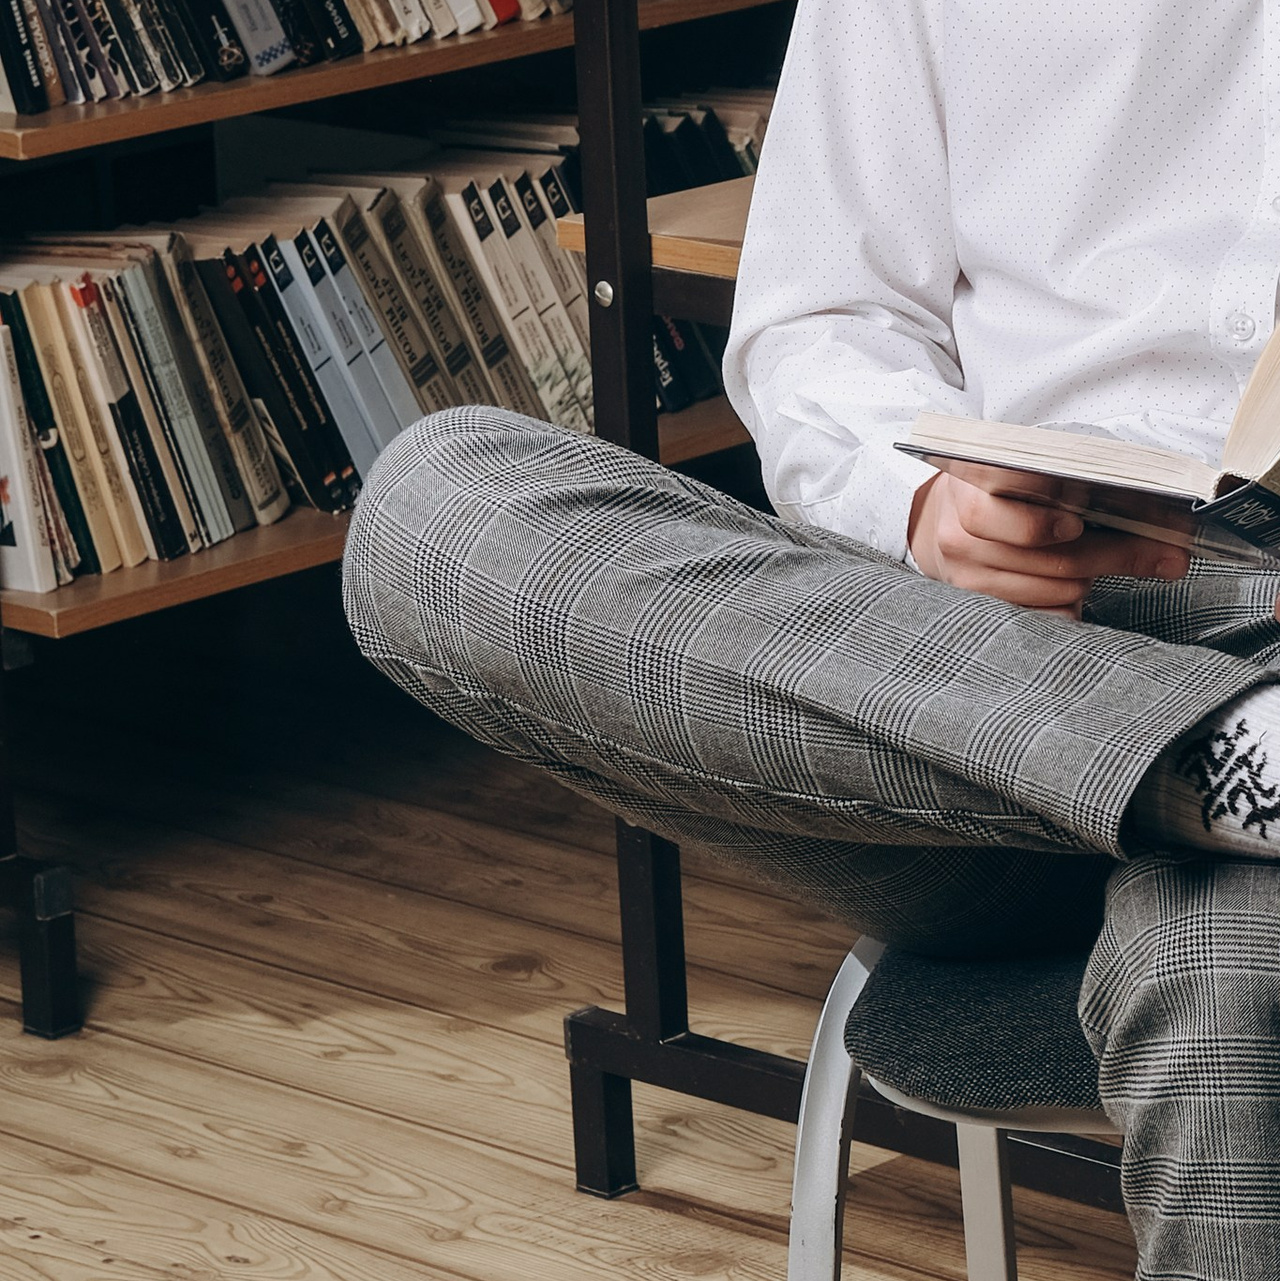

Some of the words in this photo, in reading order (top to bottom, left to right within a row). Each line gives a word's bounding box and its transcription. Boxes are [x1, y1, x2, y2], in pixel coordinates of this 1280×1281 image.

[355, 247, 387, 301] ГАСЯТ
[392, 239, 422, 290] ГАСЯТ
[436, 229, 464, 281] ГАСЯТ
[455, 254, 484, 304] ВЕТЕР
[378, 273, 409, 324] ВЕТЕР
[416, 264, 445, 313] ВЕТЕР
[383, 303, 420, 365] ВОЛНЫ
[419, 294, 455, 354] ВОЛНЫ
[460, 286, 492, 345] ВОЛНЫ
